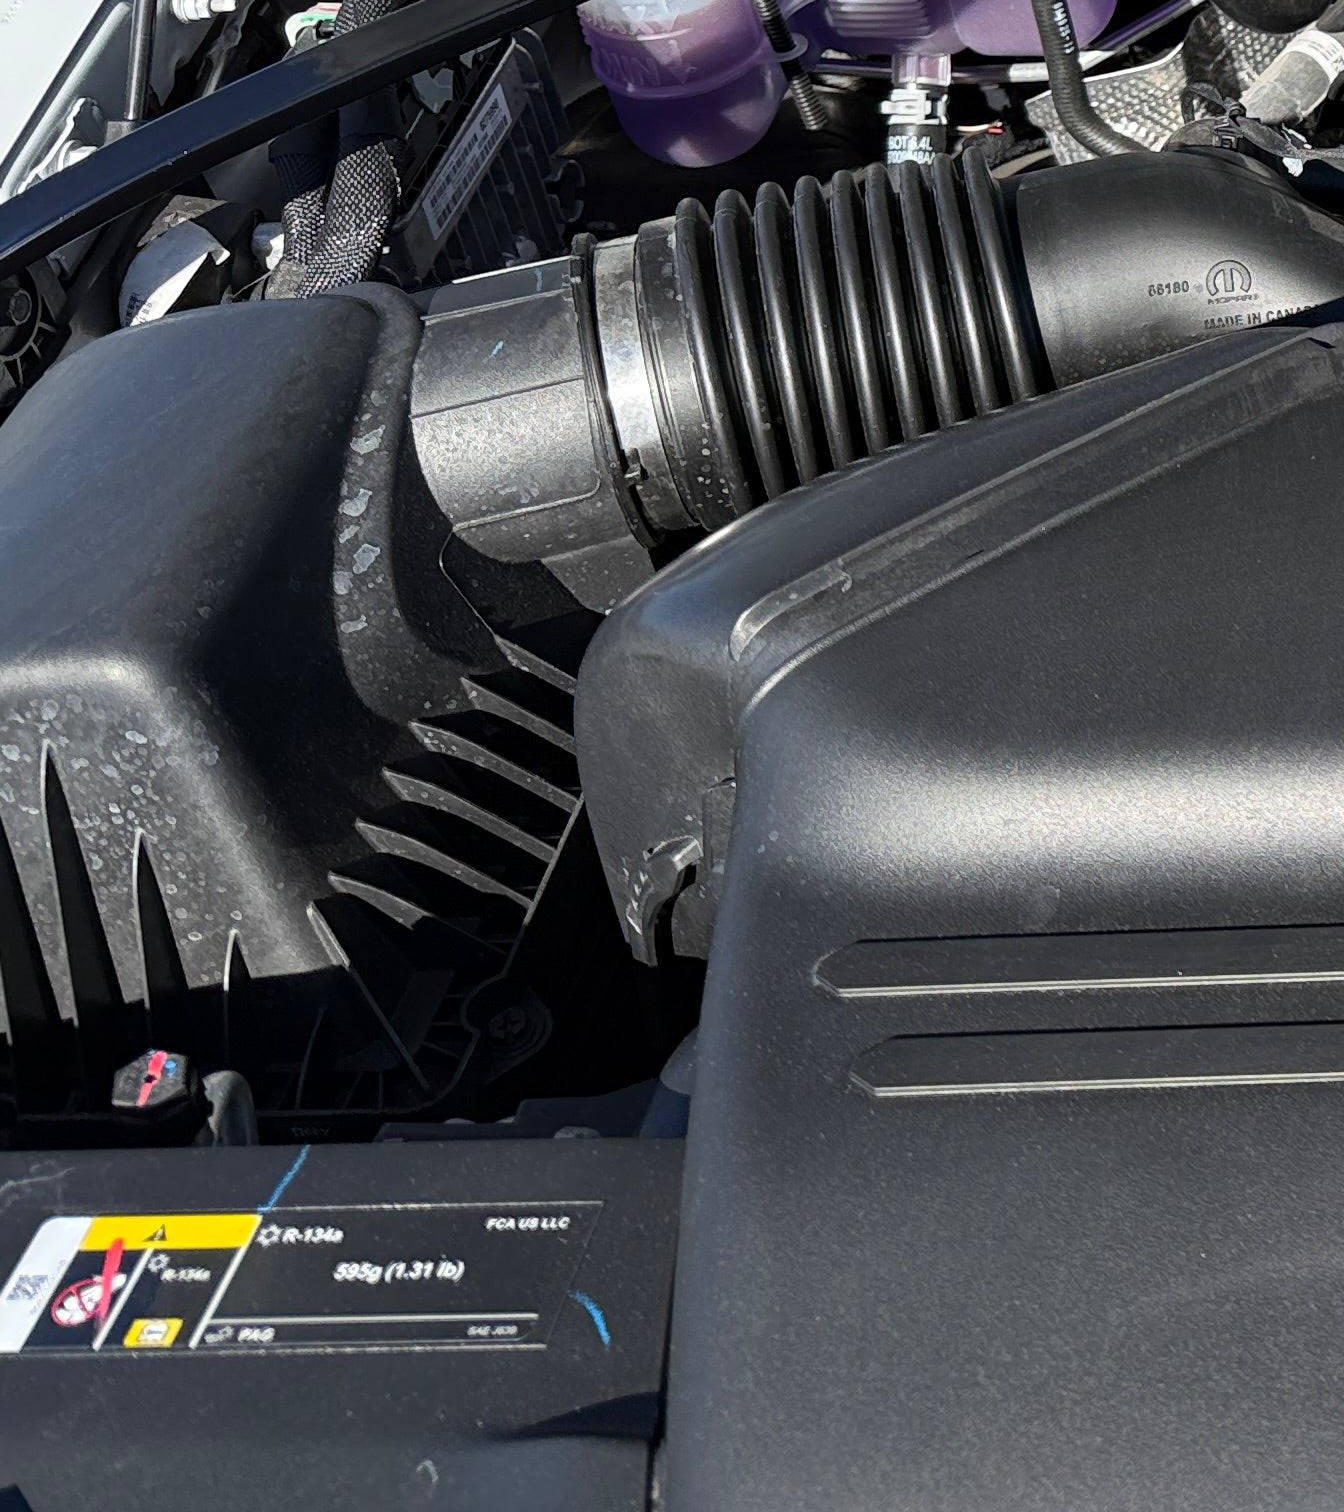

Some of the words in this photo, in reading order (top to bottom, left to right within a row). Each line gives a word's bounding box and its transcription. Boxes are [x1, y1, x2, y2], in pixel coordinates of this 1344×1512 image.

[1204, 313, 1244, 330] MADE
[1247, 311, 1262, 325] IN
[485, 1217, 516, 1230] FCA
[541, 1216, 571, 1230] LLC
[281, 1226, 344, 1244] R-134a
[384, 1259, 432, 1284] (1.31
